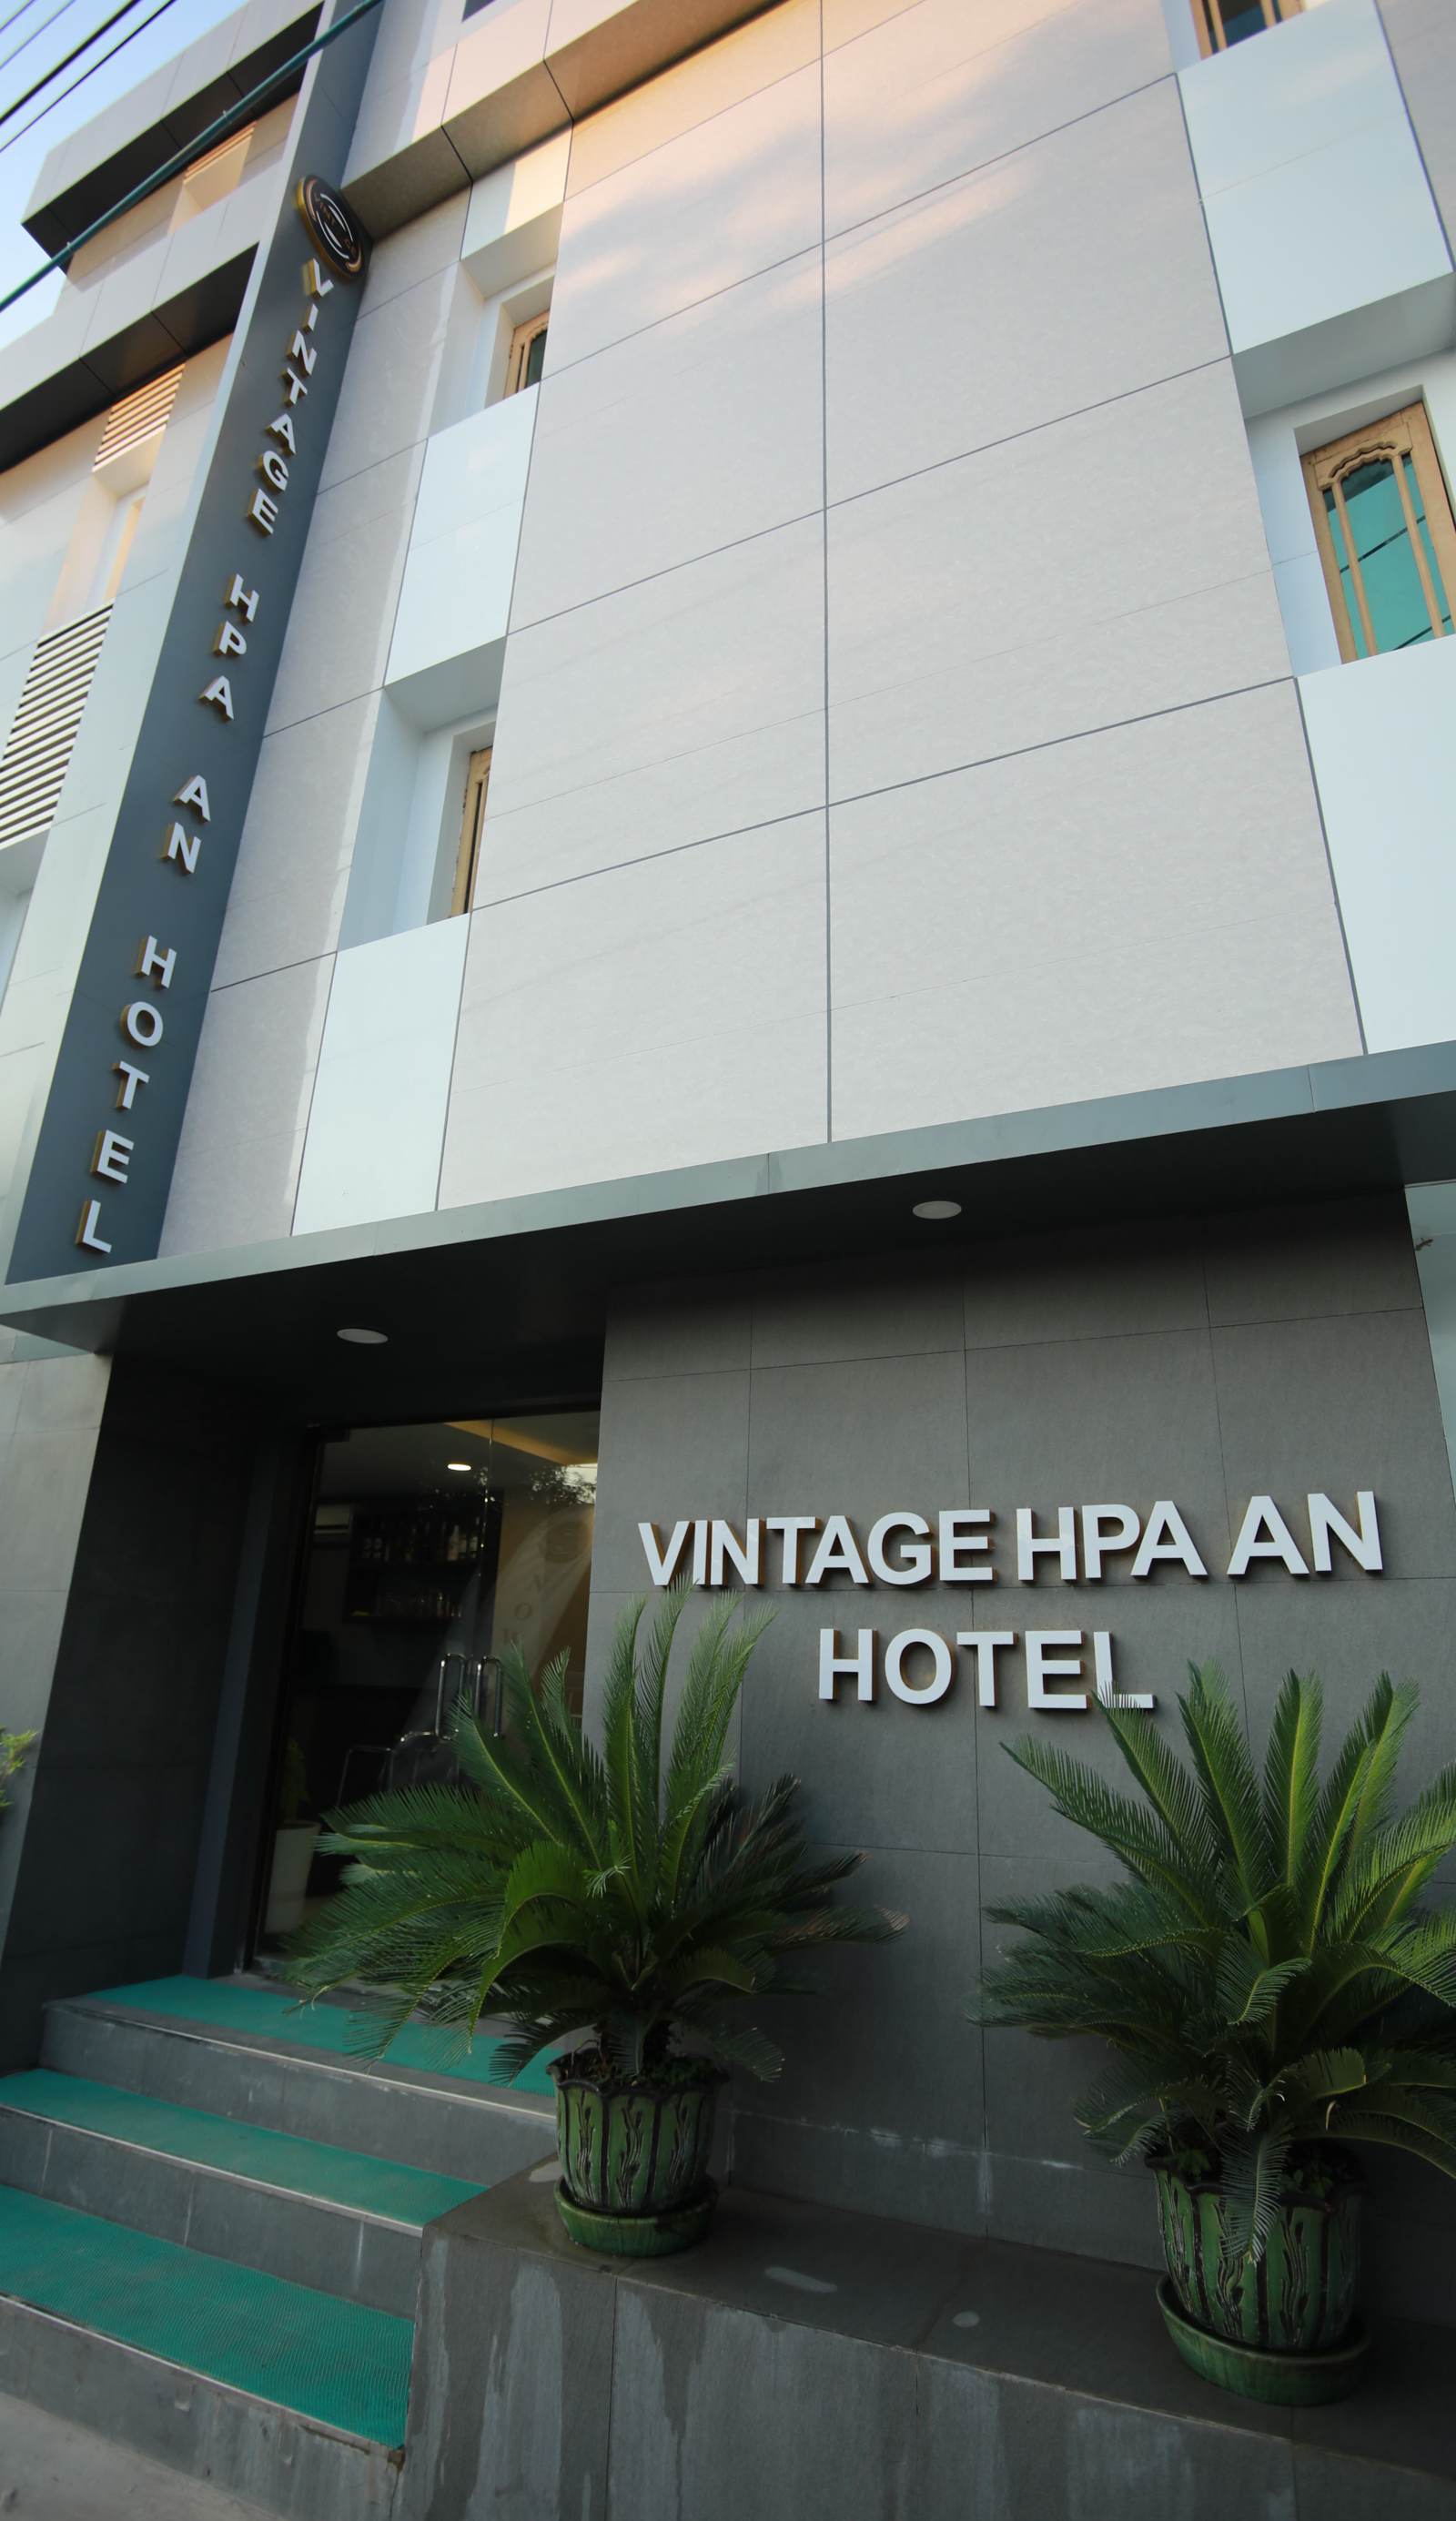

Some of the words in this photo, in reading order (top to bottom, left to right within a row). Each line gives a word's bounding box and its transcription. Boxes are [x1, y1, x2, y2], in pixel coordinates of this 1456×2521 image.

[247, 258, 333, 536] VINTAGE
[199, 573, 259, 720] HPA
[161, 774, 211, 874] AN
[76, 935, 177, 1254] HOTEL
[637, 1508, 996, 1586] VINTAGE
[1016, 1500, 1208, 1581] HPA
[1227, 1490, 1384, 1576] AN
[818, 1626, 1155, 1711] HOTEL
